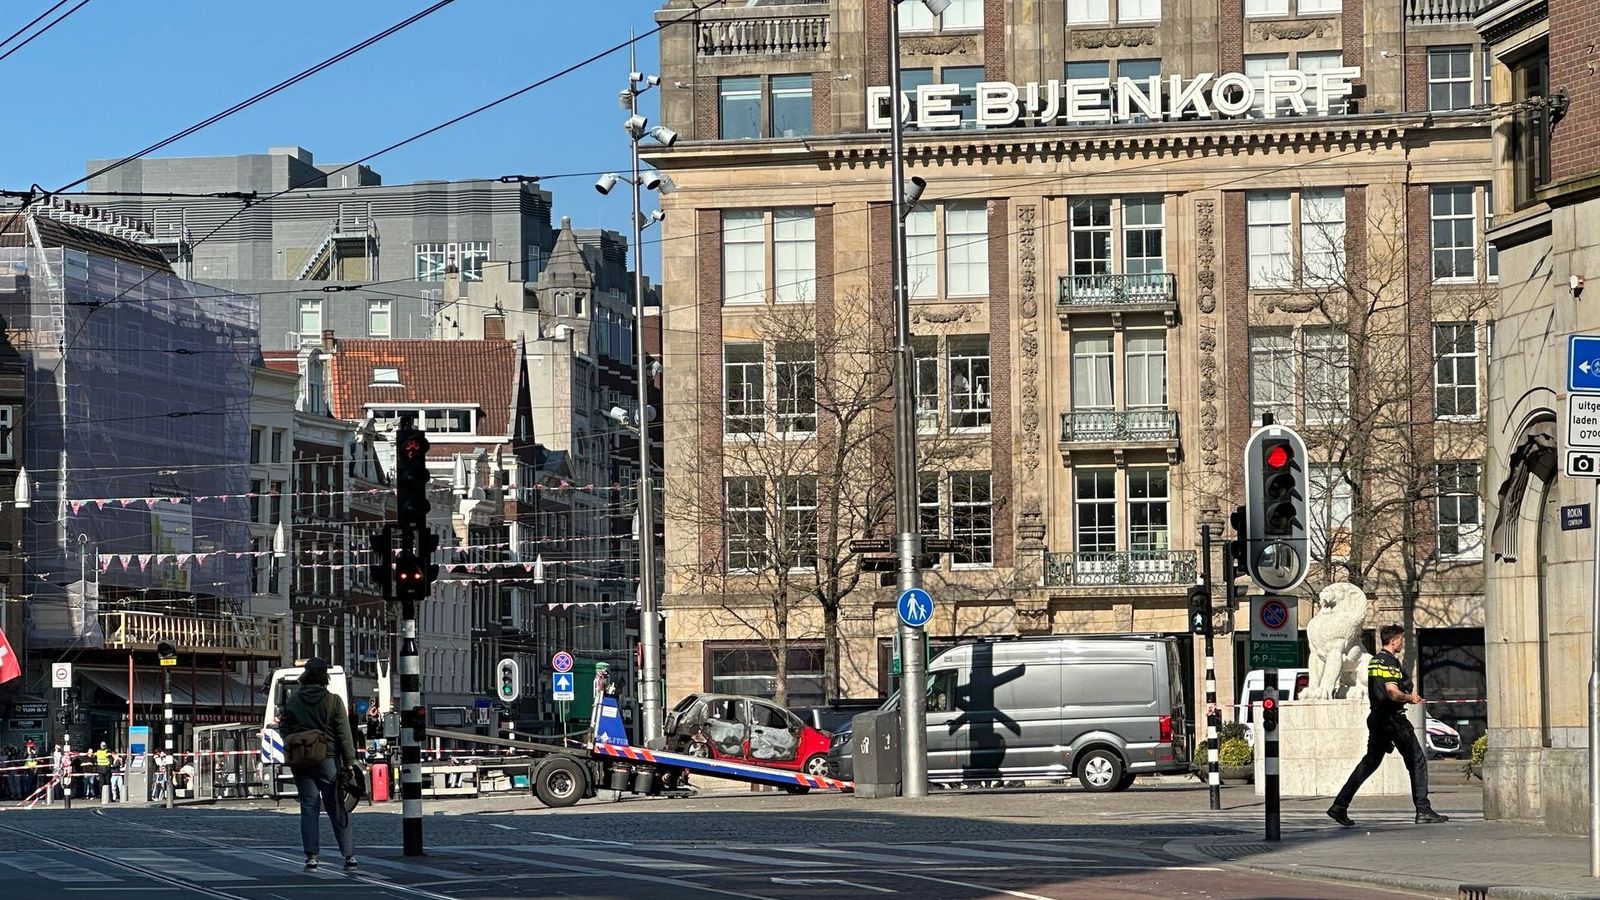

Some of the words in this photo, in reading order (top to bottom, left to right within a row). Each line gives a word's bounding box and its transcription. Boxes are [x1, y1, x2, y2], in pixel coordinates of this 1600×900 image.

[867, 84, 960, 129] DE
[976, 66, 1361, 125] BIJENKORF
[1572, 415, 1598, 425] laden
[121, 713, 143, 721] HOEL
